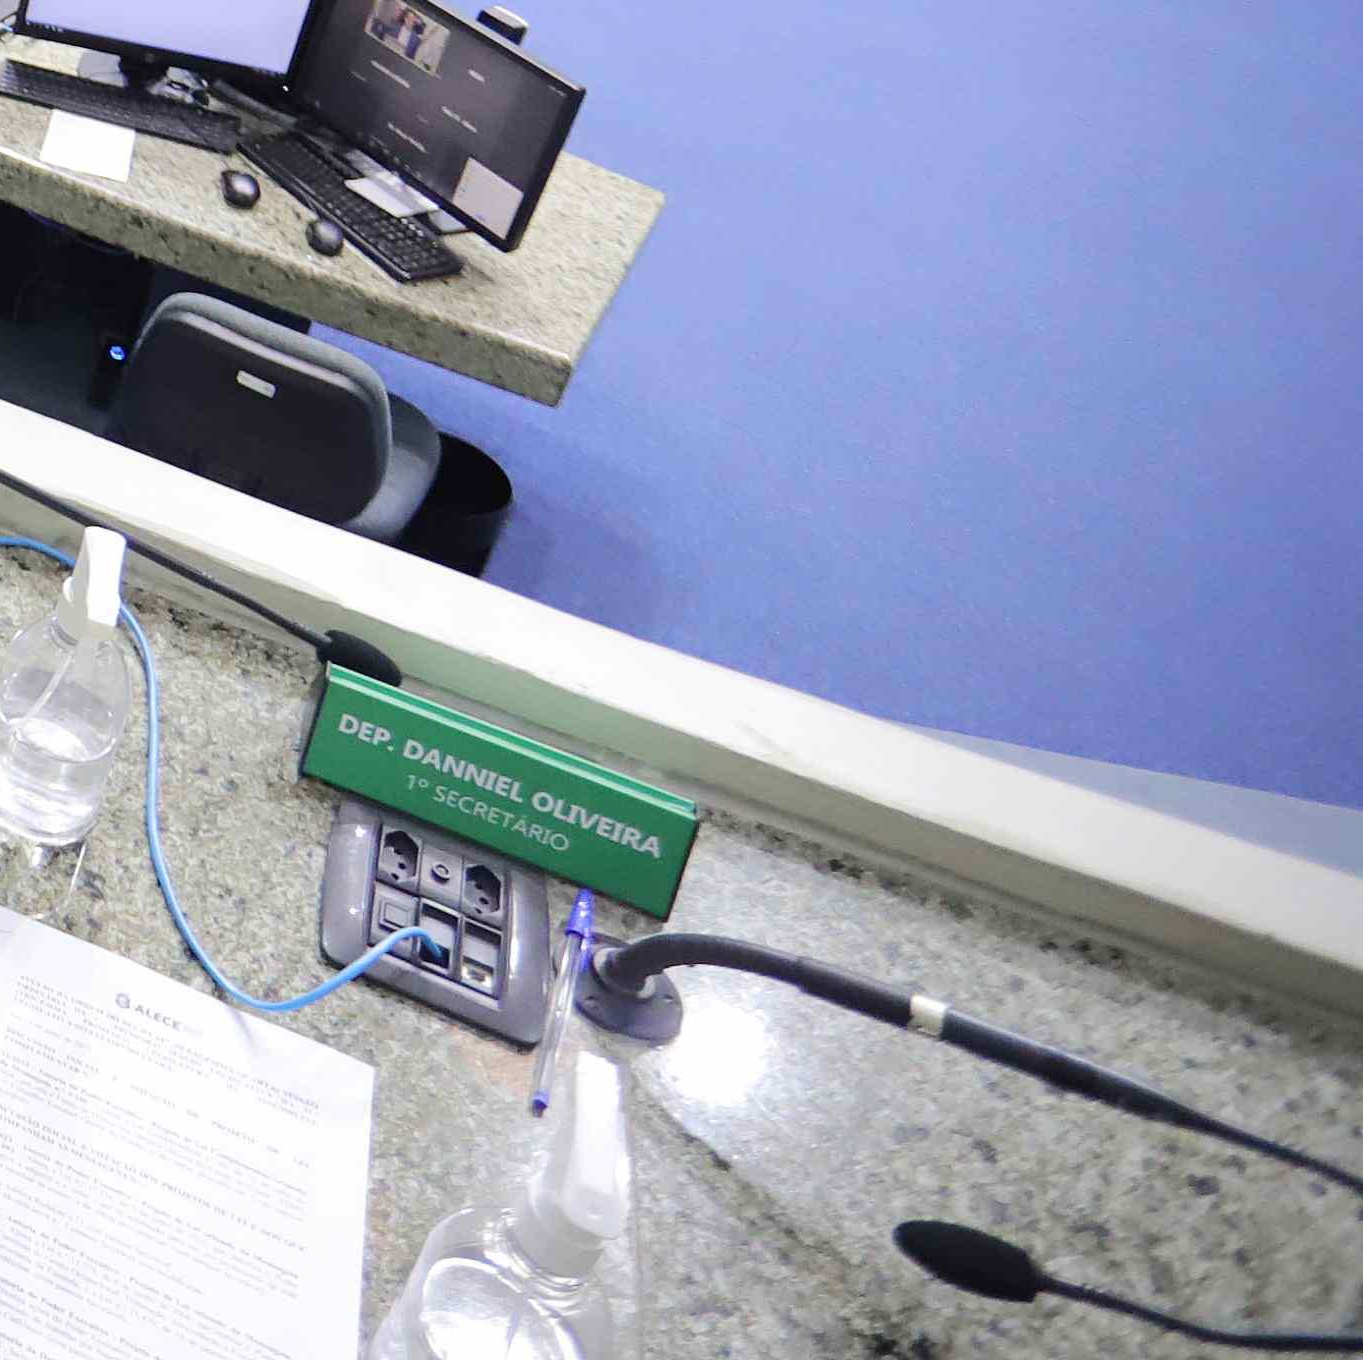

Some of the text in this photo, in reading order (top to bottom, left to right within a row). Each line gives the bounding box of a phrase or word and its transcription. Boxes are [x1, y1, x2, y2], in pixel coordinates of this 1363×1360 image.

[338, 713, 663, 859] DEP. DANNIEL OLIVEIRA
[407, 774, 570, 852] 1º SECRETÁRIO
[134, 1004, 182, 1032] ALECE
